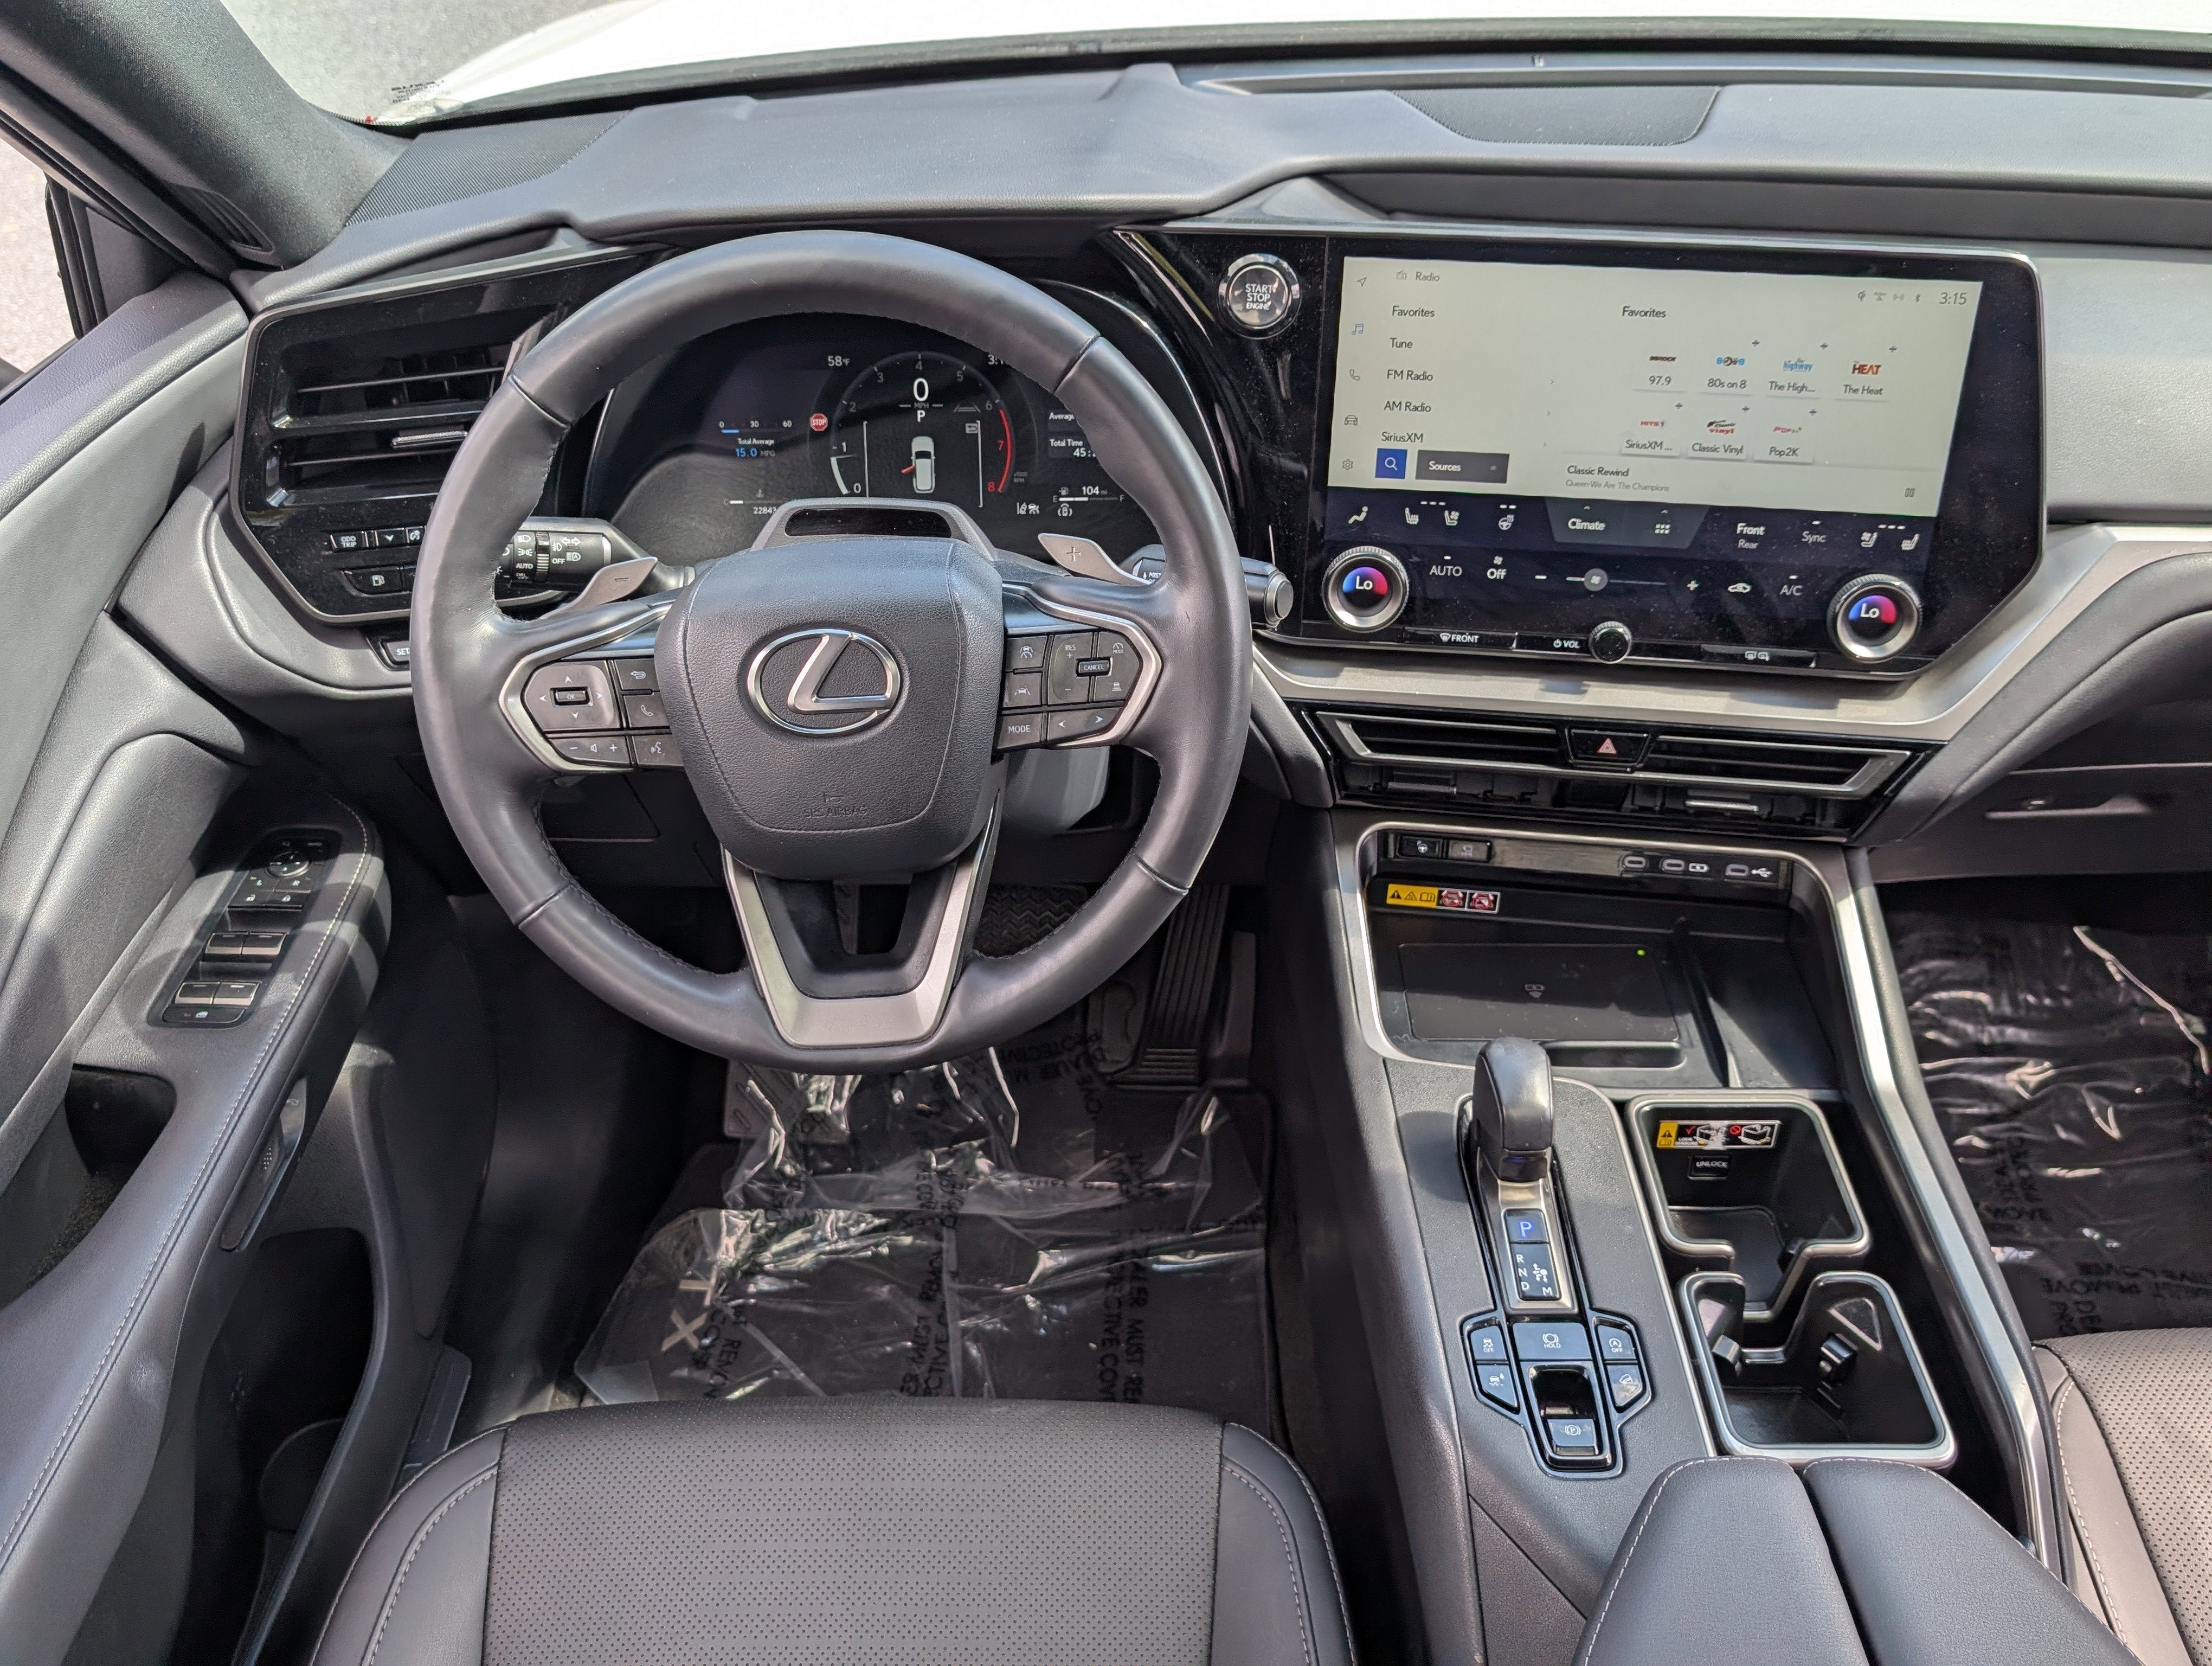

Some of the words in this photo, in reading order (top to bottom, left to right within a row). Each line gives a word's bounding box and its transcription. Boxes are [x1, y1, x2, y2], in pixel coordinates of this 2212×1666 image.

[1415, 272, 1440, 283] Radio
[1245, 283, 1272, 293] START
[1246, 293, 1271, 302] STOP
[1939, 291, 1967, 306] 3:15
[1246, 302, 1269, 310] ENGINE
[1391, 305, 1436, 318] Favorites
[1621, 305, 1667, 319] Favorites
[1390, 337, 1413, 350] Tune
[915, 361, 922, 371] 4
[1851, 363, 1882, 375] HEAT
[877, 372, 884, 383] 3
[956, 371, 964, 381] 5
[1386, 369, 1403, 381] FM
[1406, 370, 1433, 382] Radio
[1649, 375, 1672, 386] 97.9
[1707, 377, 1725, 389] 80s
[1726, 381, 1738, 389] on
[1739, 379, 1747, 389] 8
[1769, 380, 1785, 392] The
[912, 377, 929, 402] 0
[1843, 383, 1859, 395] The
[1861, 385, 1883, 396] Heat
[849, 402, 857, 413] 2
[985, 400, 993, 411] 6
[1383, 400, 1403, 412] AM
[1404, 402, 1432, 413] Radio
[917, 410, 926, 422] P
[782, 420, 793, 428] 60
[811, 418, 826, 426] STOP
[751, 438, 775, 446] Average
[1049, 438, 1066, 447] Total
[1067, 438, 1084, 447] Time
[1381, 431, 1424, 444] SiriusXM
[841, 442, 847, 452] 1
[998, 440, 1004, 451] 7
[1624, 439, 1664, 451] SiriusXM
[1691, 441, 1721, 453] Classic
[1722, 443, 1744, 456] Vinyl
[735, 448, 757, 458] 15.0
[1769, 446, 1800, 459] Pop2K
[1428, 460, 1462, 473] Sources
[1567, 465, 1596, 476] Classic
[1597, 466, 1630, 477] Rewind
[853, 483, 861, 494] 0
[987, 482, 995, 492] 8
[1082, 486, 1099, 496] 104
[1603, 481, 1616, 489] Are
[1617, 482, 1631, 491] The
[1631, 482, 1670, 492] Champions
[1568, 518, 1606, 531] Climate
[1736, 522, 1765, 536] Front
[1801, 530, 1827, 544] Sync
[1738, 539, 1759, 550] Rear
[1429, 565, 1463, 578] AUTO
[1487, 568, 1507, 580] Off
[1354, 574, 1374, 591] Lo
[1779, 584, 1803, 597] A/C
[1860, 602, 1880, 619] Lo
[1451, 633, 1480, 644] FRONT
[1563, 640, 1580, 650] VOL
[1008, 725, 1031, 733] MODE
[1520, 1220, 1532, 1238] P
[1516, 1254, 1525, 1264] R
[1517, 1267, 1528, 1277] N
[1521, 1281, 1531, 1291] D
[1542, 1286, 1553, 1296] M
